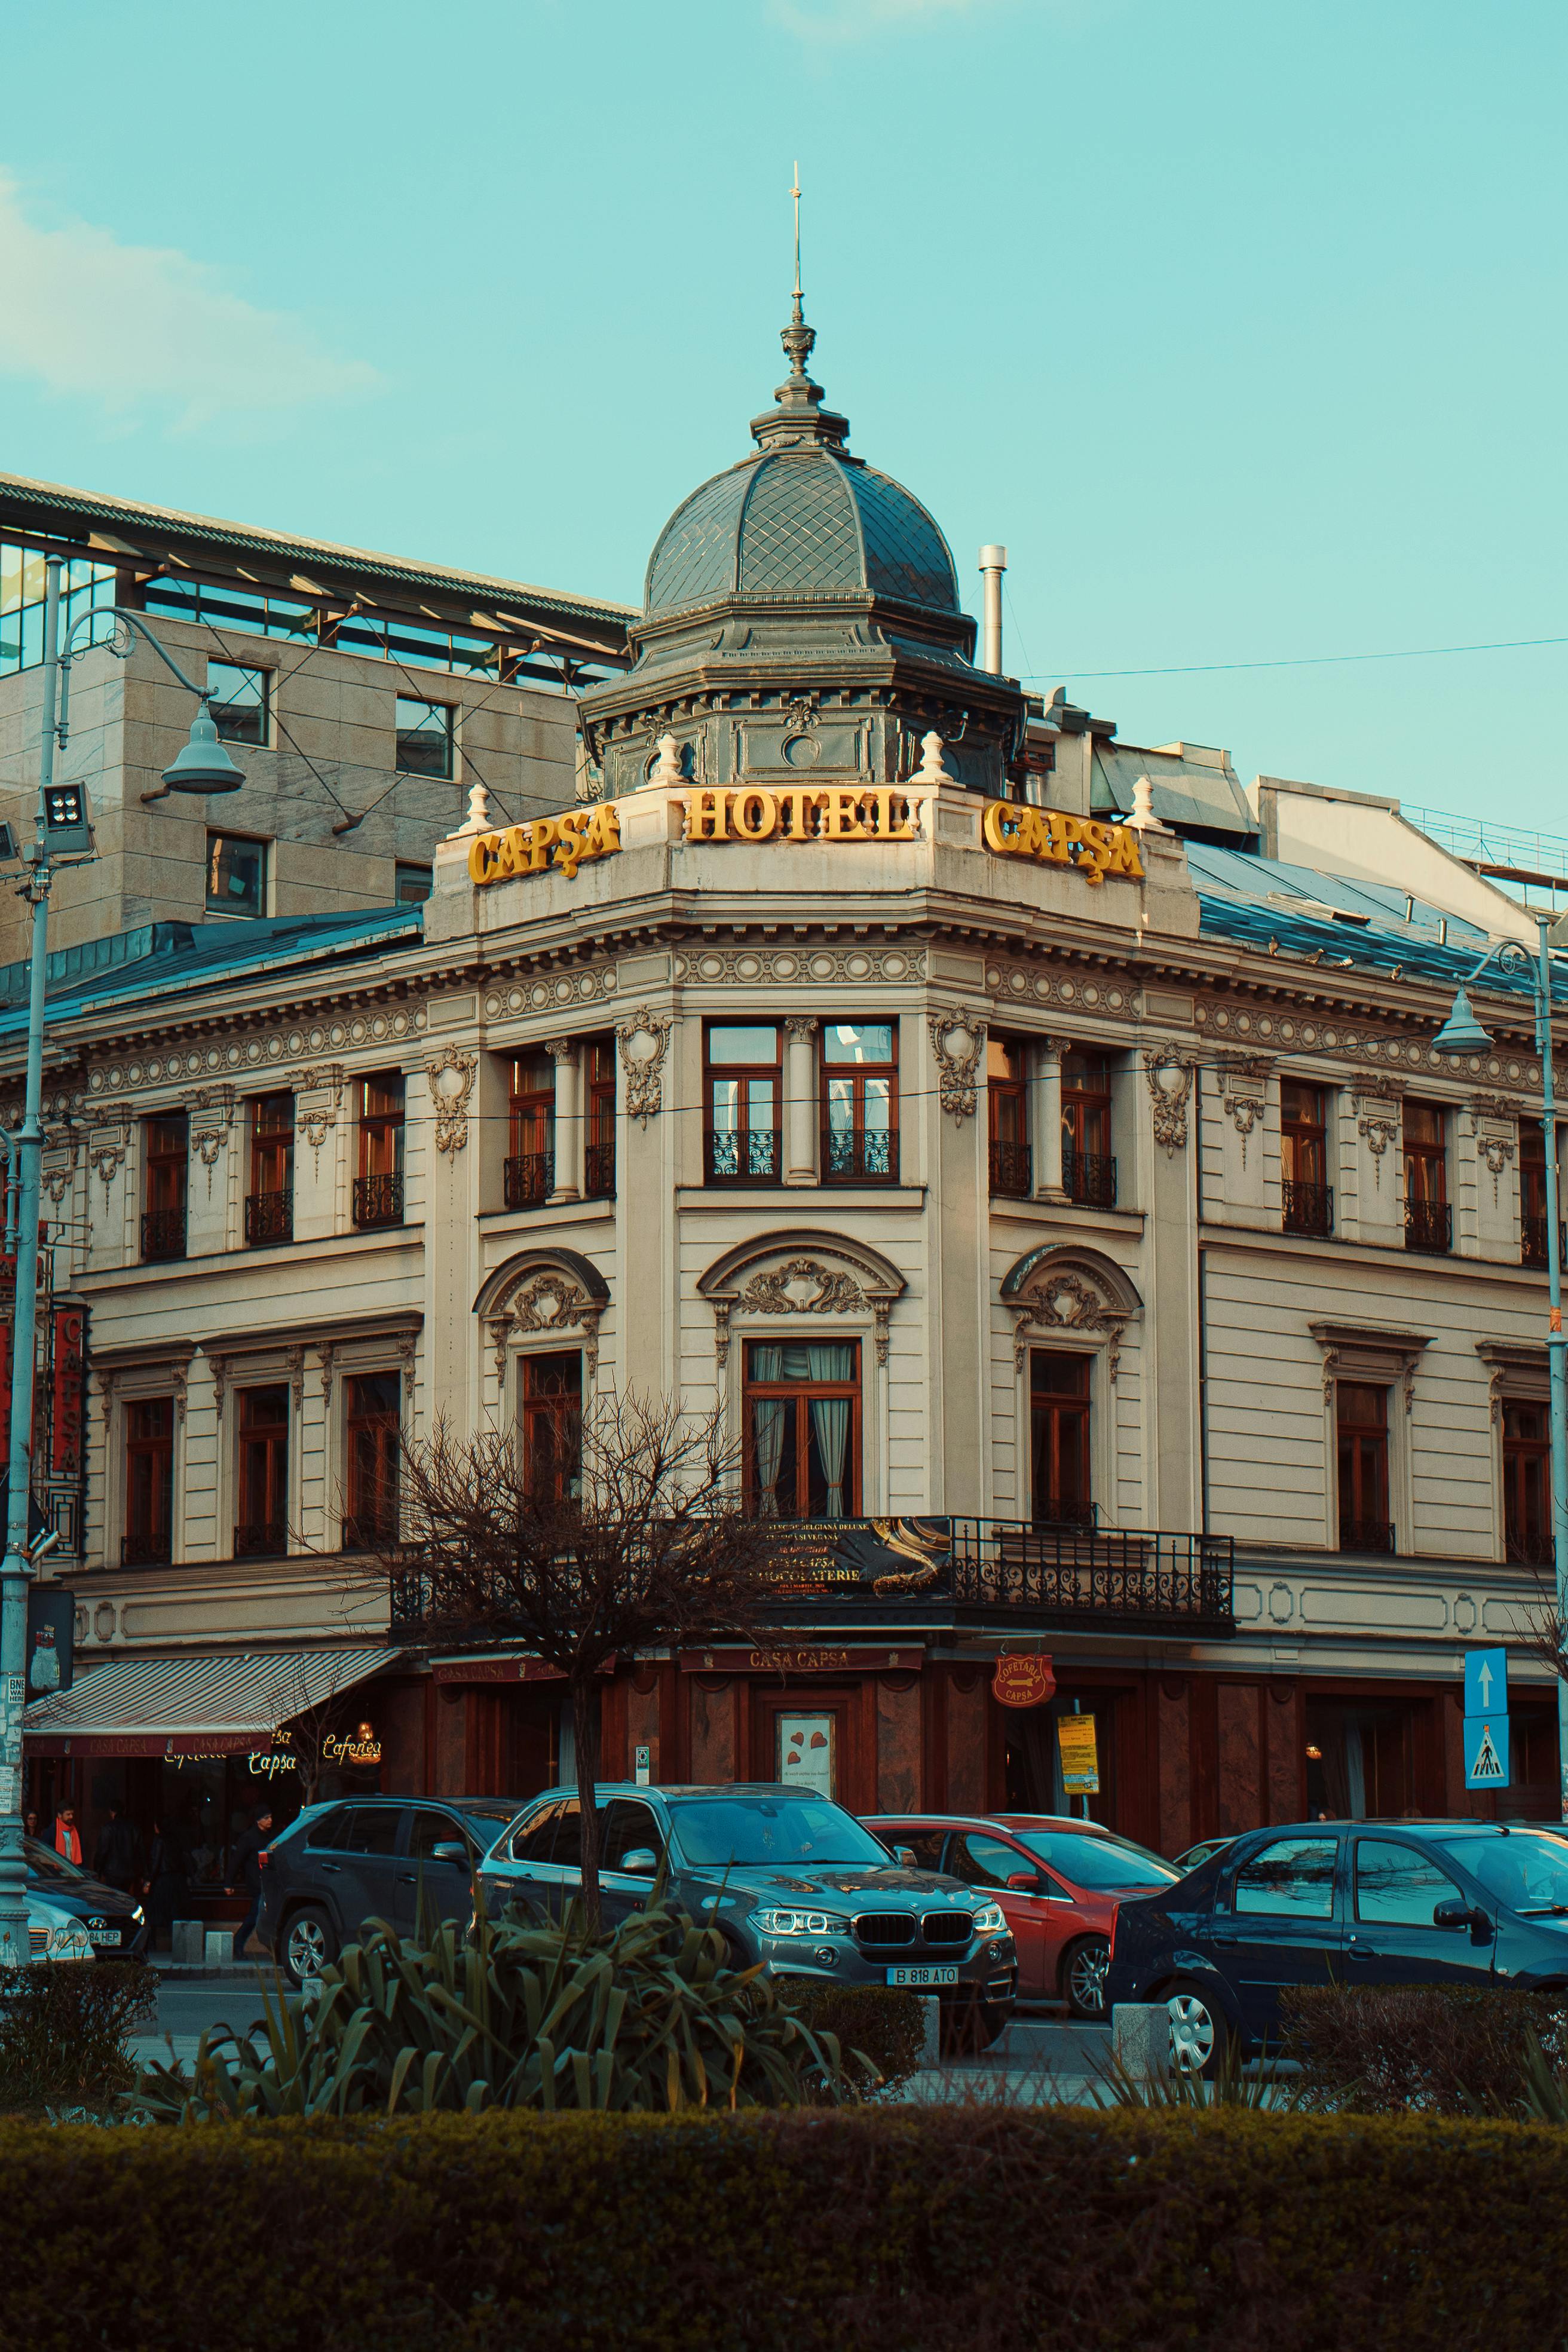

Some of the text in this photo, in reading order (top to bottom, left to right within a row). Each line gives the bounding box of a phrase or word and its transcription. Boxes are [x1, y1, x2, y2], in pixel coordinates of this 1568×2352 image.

[685, 788, 914, 841] HOTEL
[750, 1652, 793, 1667] CASA
[90, 1738, 114, 1753] CASA
[193, 1737, 218, 1752] CASA
[101, 1932, 119, 1941] HEP
[897, 1969, 956, 1983] B 818 ATO
